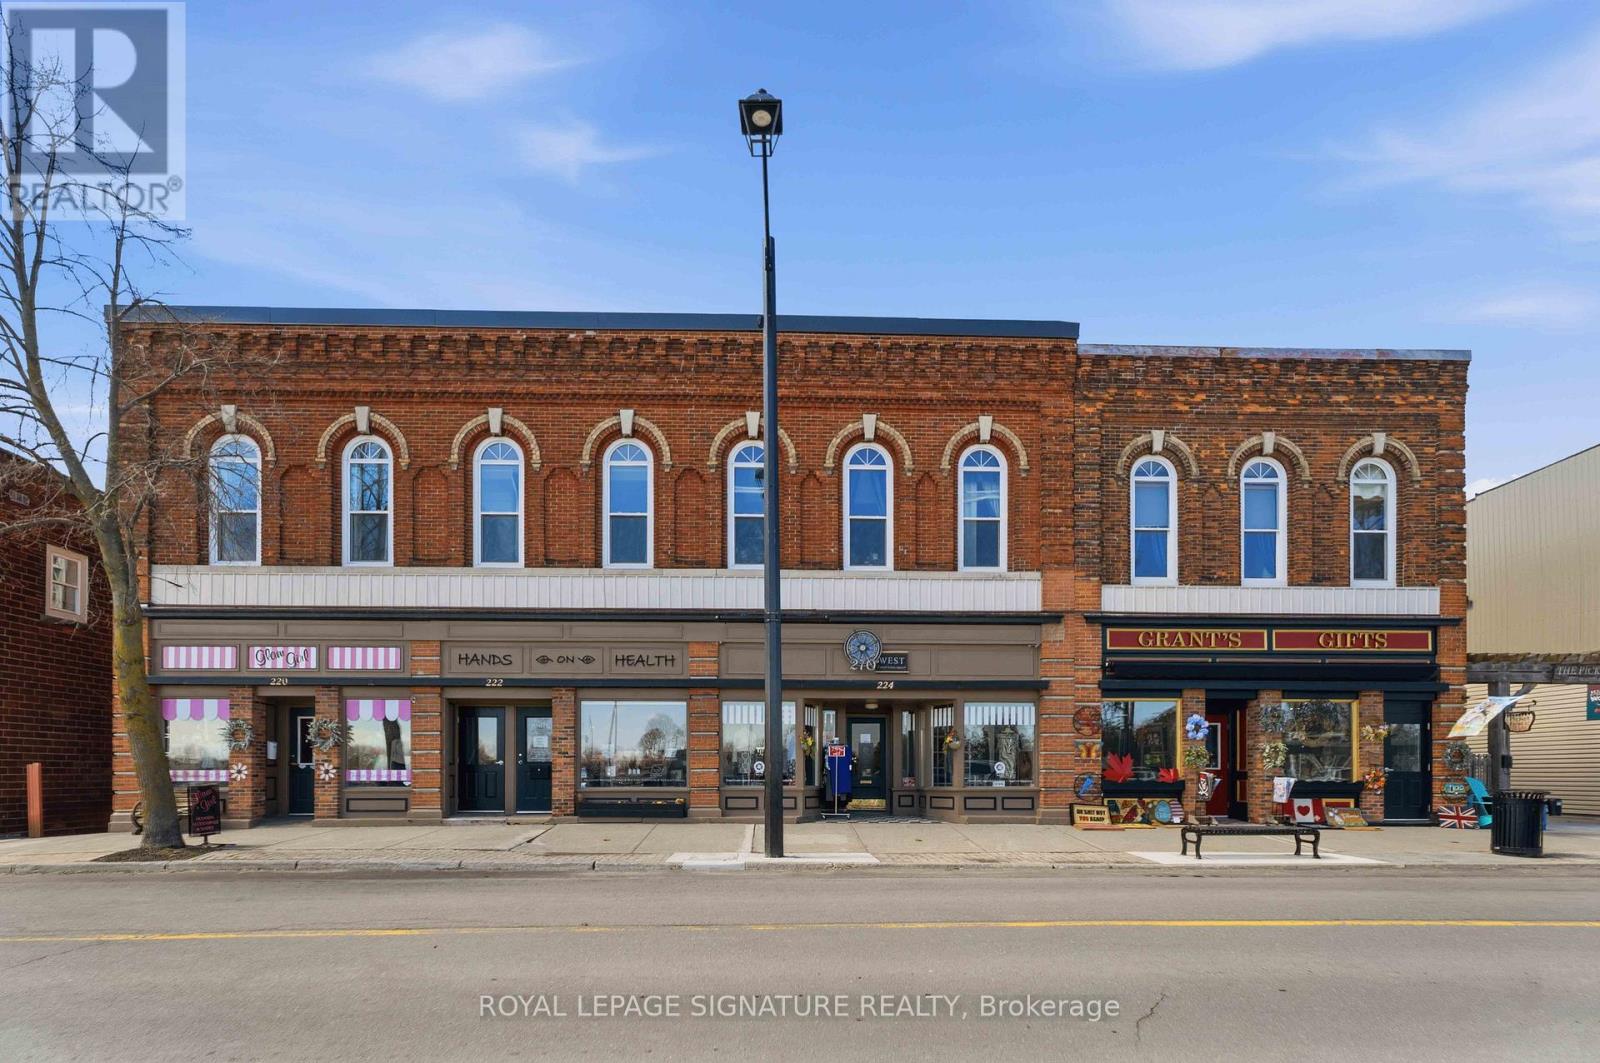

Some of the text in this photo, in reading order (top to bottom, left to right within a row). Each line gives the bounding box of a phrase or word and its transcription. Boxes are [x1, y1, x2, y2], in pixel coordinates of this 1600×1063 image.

[1138, 631, 1388, 648] GRANT'S GIFTS
[458, 653, 676, 667] HANDS ON HEALTH
[879, 656, 905, 665] WEST
[270, 677, 288, 686] 220
[485, 678, 504, 687] 222
[876, 681, 894, 689] 224
